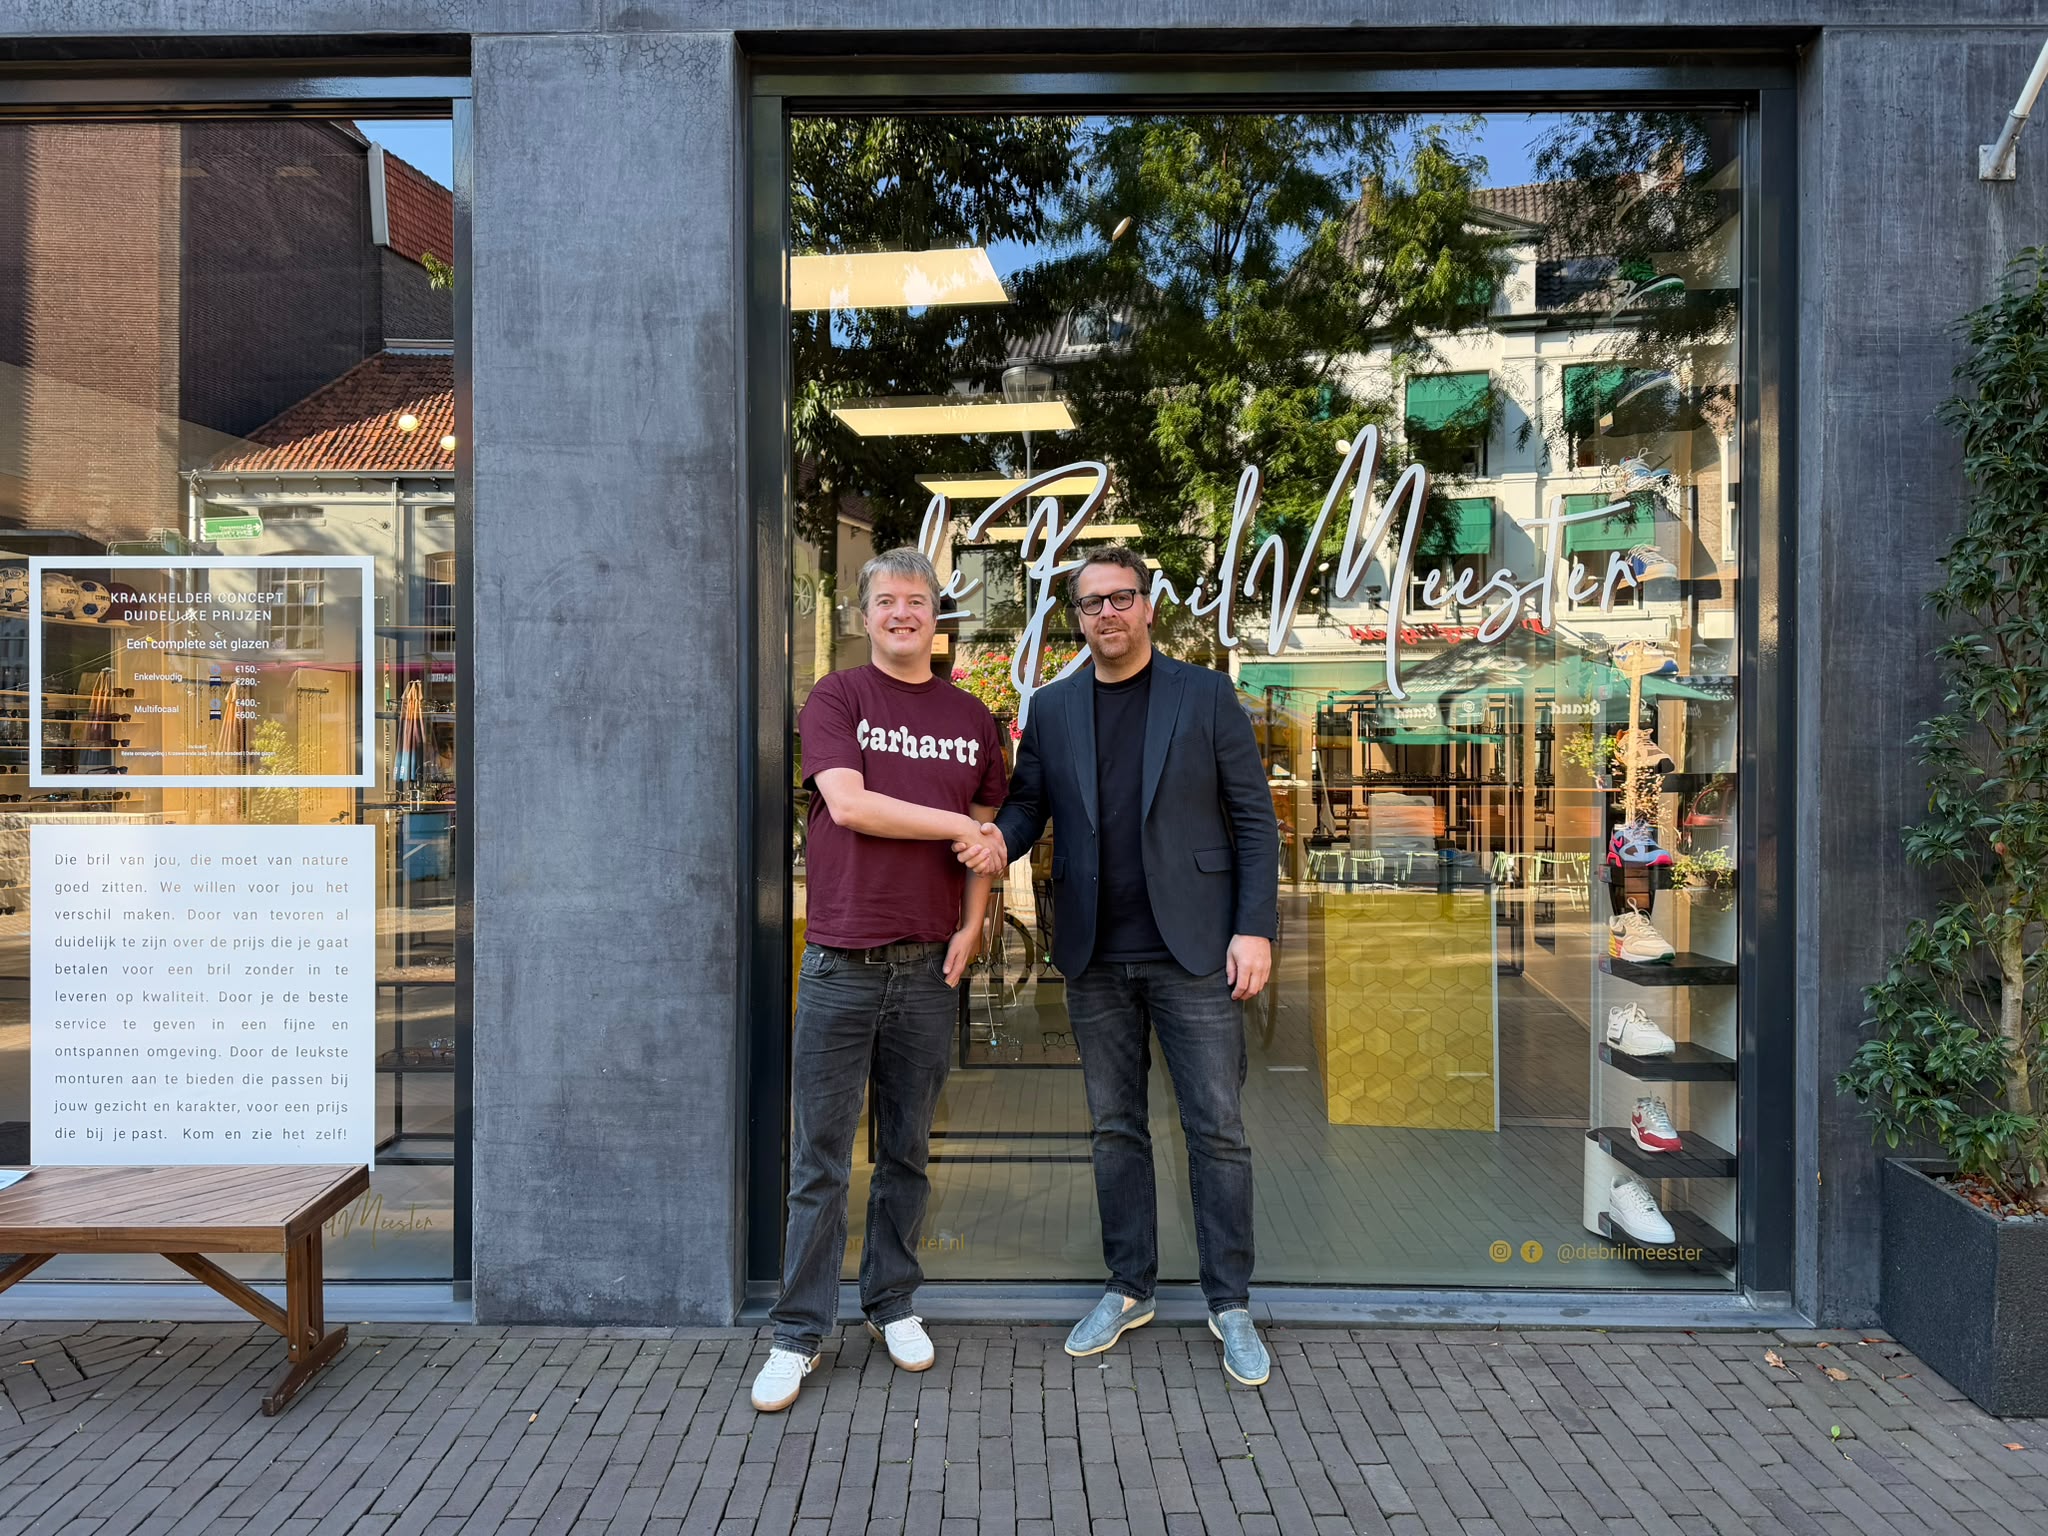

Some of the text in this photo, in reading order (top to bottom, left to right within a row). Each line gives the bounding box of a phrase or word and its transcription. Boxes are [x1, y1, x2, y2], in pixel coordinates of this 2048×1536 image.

[110, 592, 212, 604] KRAAKHELDER
[218, 592, 284, 604] CONCEPT
[124, 610, 272, 621] DUIDELIJKE PRIJZEN
[126, 638, 270, 652] Een complete set glazen
[134, 672, 183, 682] Enkelvoudig
[234, 665, 261, 674] €150,-
[235, 678, 261, 687] €280,-
[134, 705, 180, 713] Multifocaal
[235, 699, 261, 708] €400,-
[235, 712, 261, 720] €600,-
[857, 719, 979, 766] Carhartt
[54, 852, 349, 869] Die bril van jou, die moet van nature
[54, 880, 349, 896] goed zitten. We willen voor jou het
[54, 907, 349, 921] verschil maken. Door van tevoren al
[54, 935, 349, 951] duidelijk te zijn over de prijs die je gaat
[54, 962, 349, 976] betalen voor een bril zonder in te
[54, 989, 349, 1006] leveren op kwaliteit. Door je de beste
[54, 1017, 349, 1033] service te geven in een fijne en
[54, 1045, 349, 1061] ontspannen omgeving. Door de leukste
[54, 1072, 349, 1089] monturen aan te bieden die passen bij
[53, 1099, 349, 1116] jouw gezicht en karakter, voor een prijs
[54, 1126, 347, 1143] die bij je past. Kom en zie het zelf!
[1557, 1243, 1703, 1263] @debrilmeester
